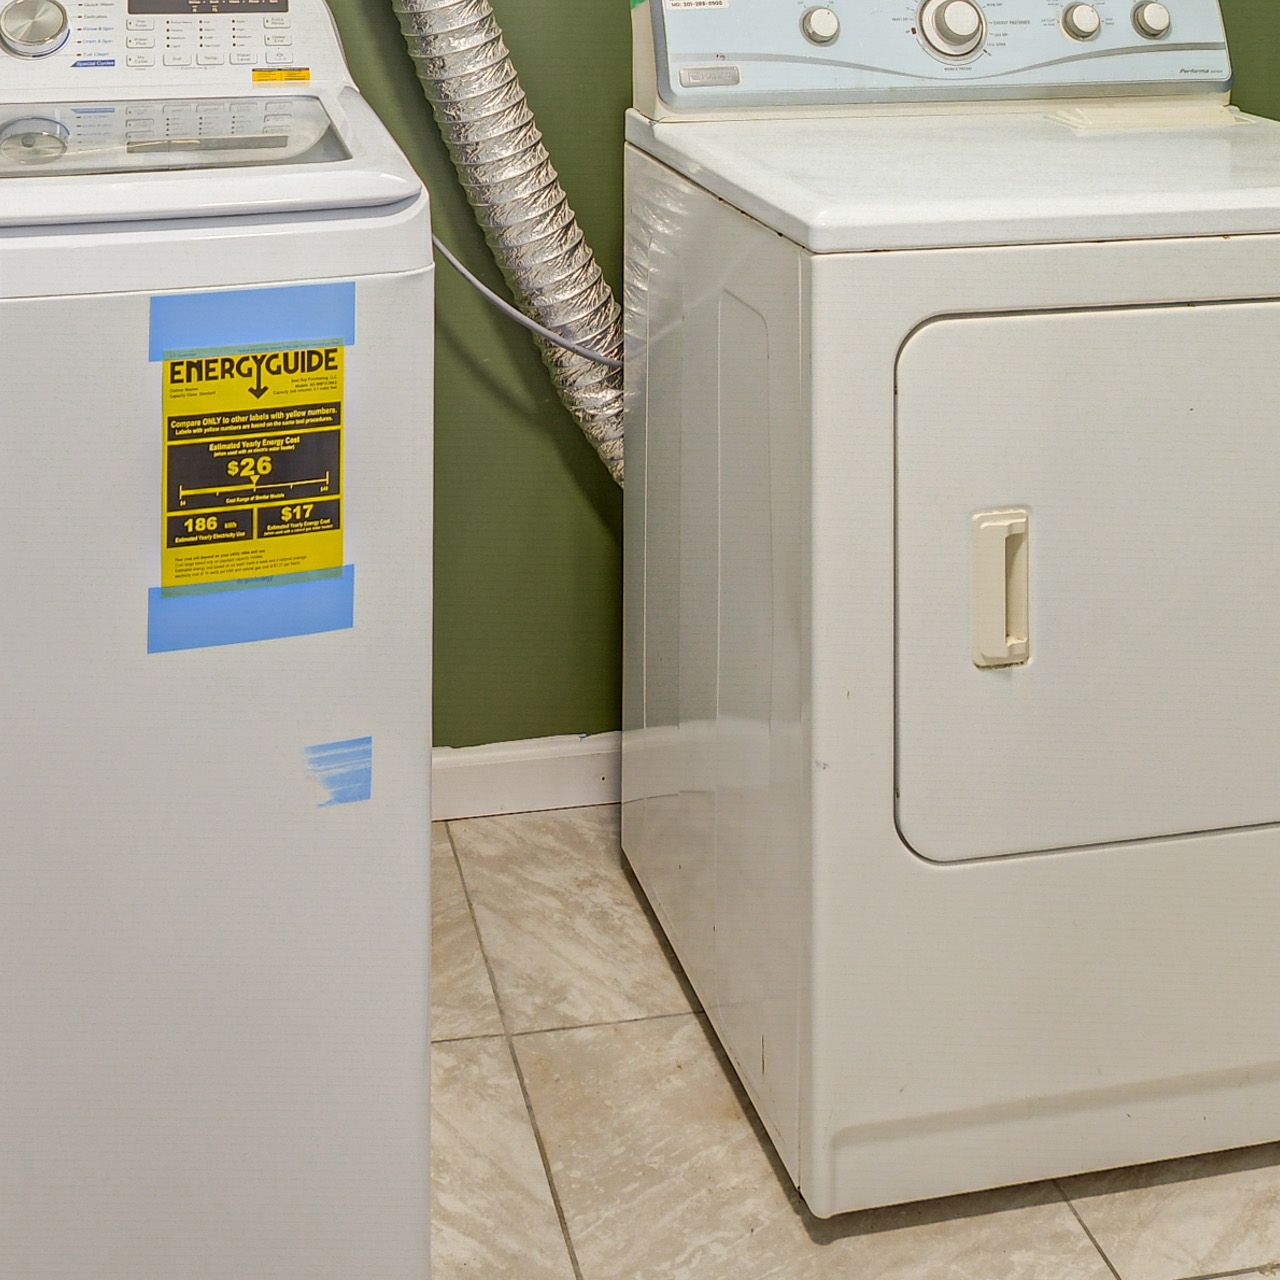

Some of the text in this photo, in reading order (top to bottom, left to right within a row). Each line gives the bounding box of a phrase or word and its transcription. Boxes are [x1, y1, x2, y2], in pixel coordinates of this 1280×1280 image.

[170, 348, 338, 384] ENERGYGUIDE
[170, 407, 338, 429] Compare ONLY to other labels with yellow numbers.
[209, 436, 300, 452] Estimated Yearly Energy Cost
[227, 455, 273, 477] $26
[281, 503, 314, 523] $17
[184, 516, 218, 533] 186
[266, 523, 290, 531] Estimated
